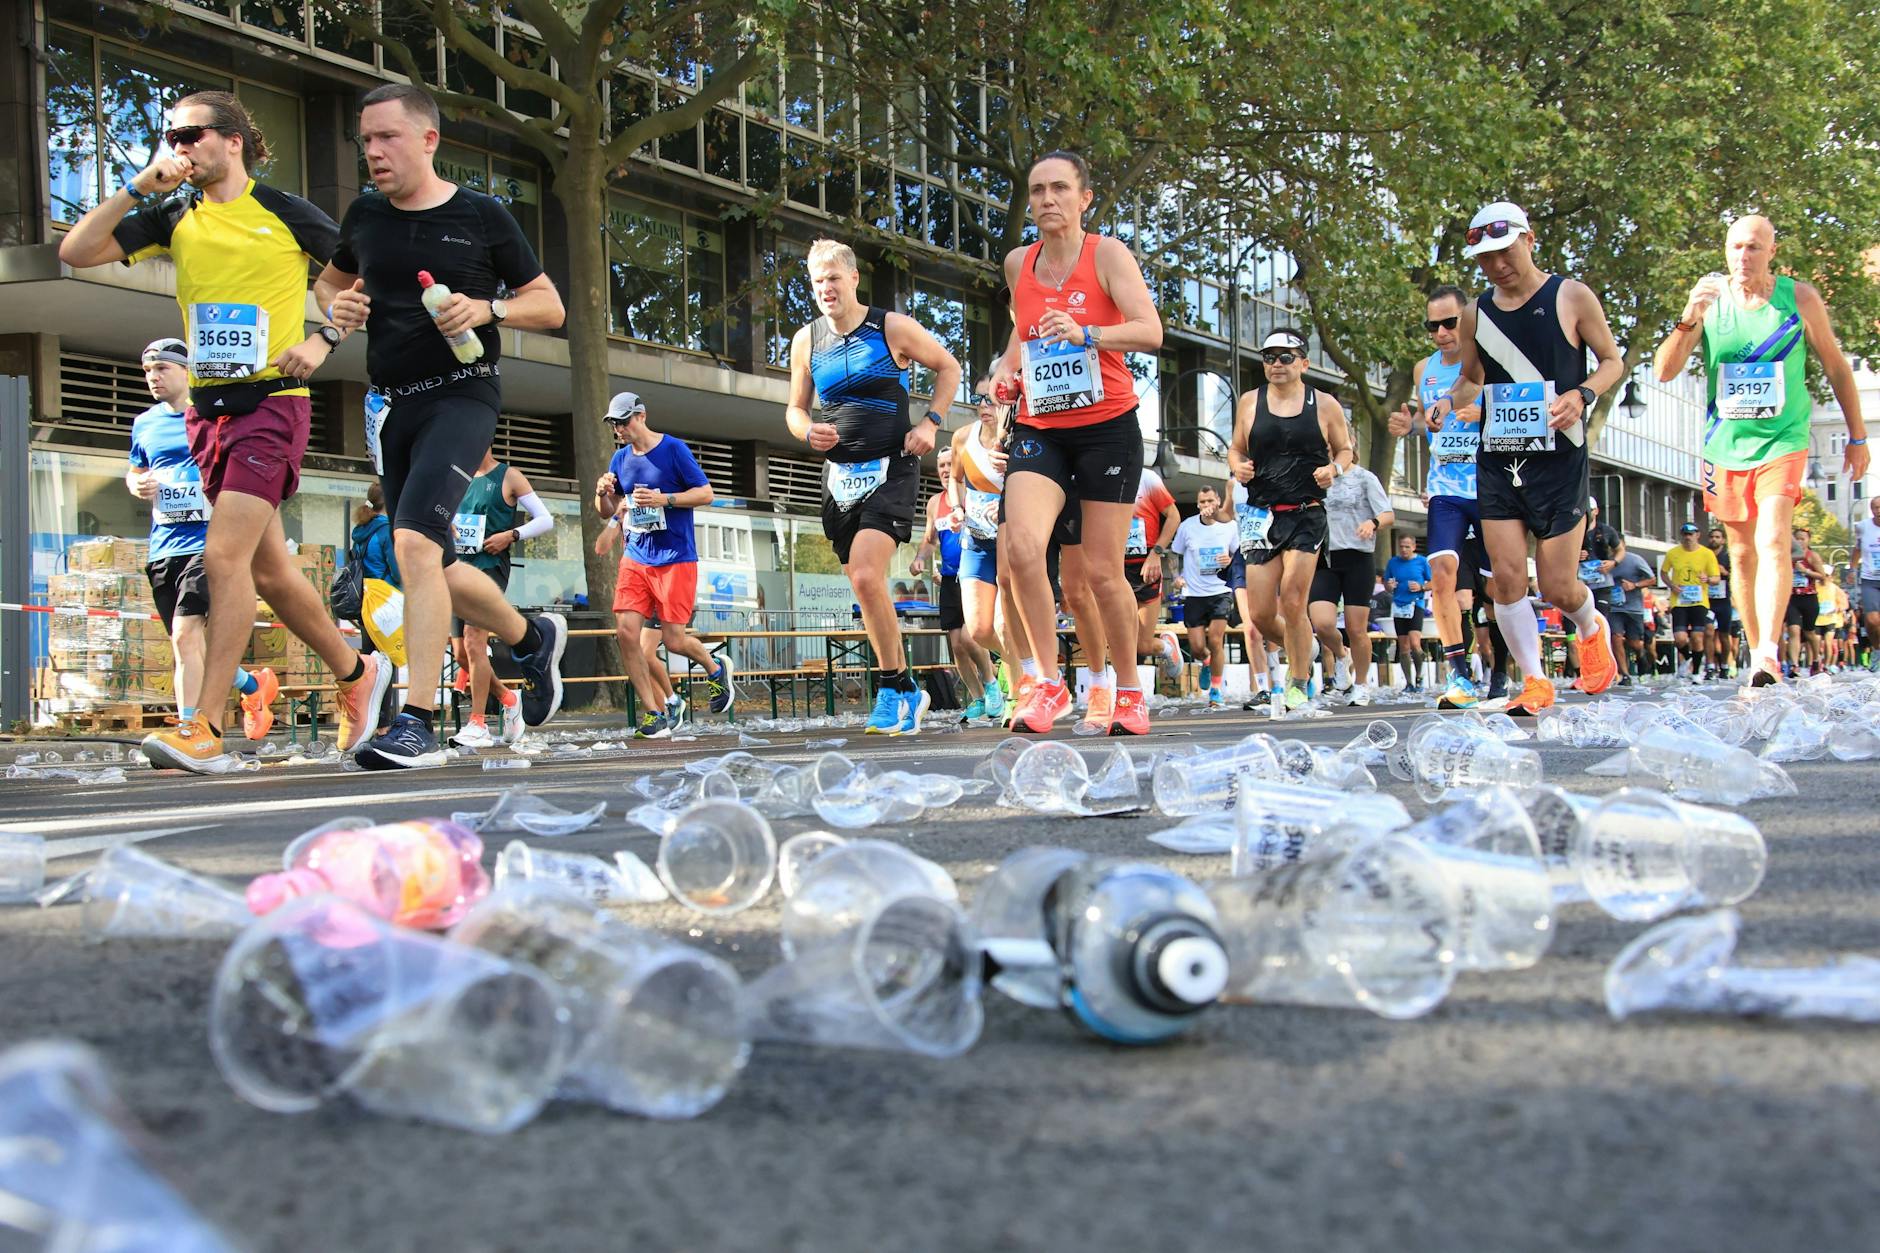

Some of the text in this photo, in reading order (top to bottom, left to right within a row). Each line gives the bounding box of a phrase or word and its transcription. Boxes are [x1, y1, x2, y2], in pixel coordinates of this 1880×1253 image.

[199, 330, 252, 347] 36693
[207, 350, 237, 360] Jasper
[1035, 359, 1083, 382] 62016
[1047, 383, 1070, 393] Anna
[1728, 382, 1771, 395] 36197
[1039, 403, 1070, 413] NOTHING
[1495, 407, 1540, 423] 51065
[1503, 426, 1528, 435] Junho
[1441, 436, 1478, 447] 22564
[1496, 444, 1524, 452] NOTHING
[159, 486, 197, 500] 19674
[799, 583, 851, 600] Augenlasern
